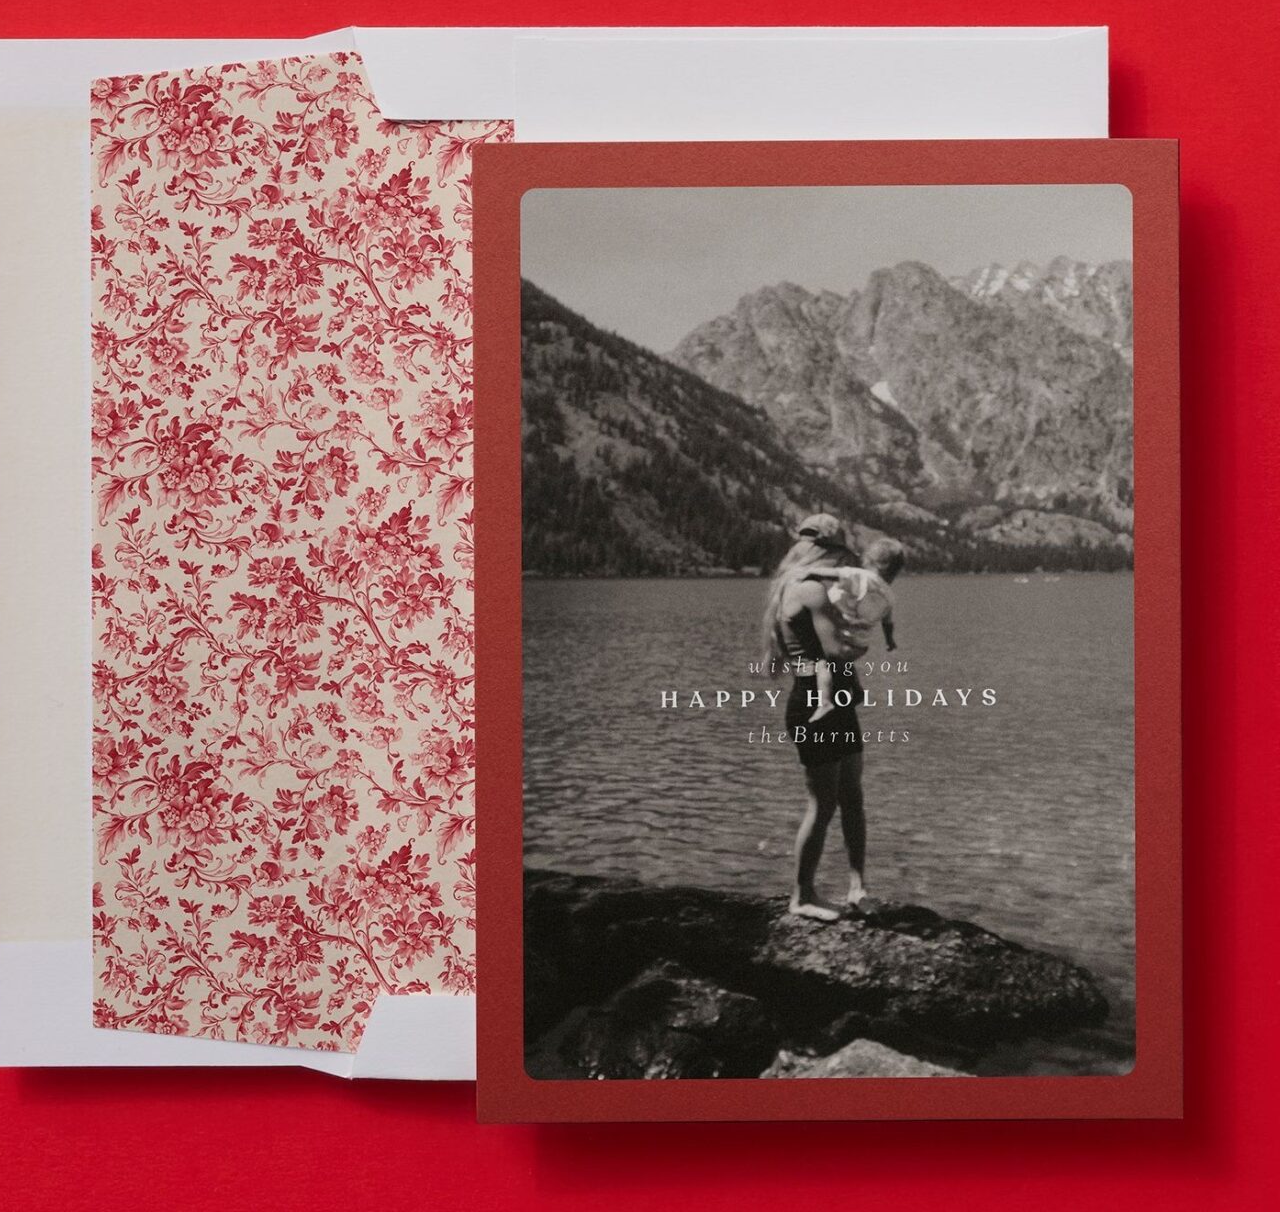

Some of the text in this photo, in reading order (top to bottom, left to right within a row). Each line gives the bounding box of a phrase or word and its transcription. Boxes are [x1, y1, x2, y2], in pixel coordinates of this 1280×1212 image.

[748, 655, 910, 676] wishing you
[660, 688, 1000, 709] HAPPY HOLIDAYS
